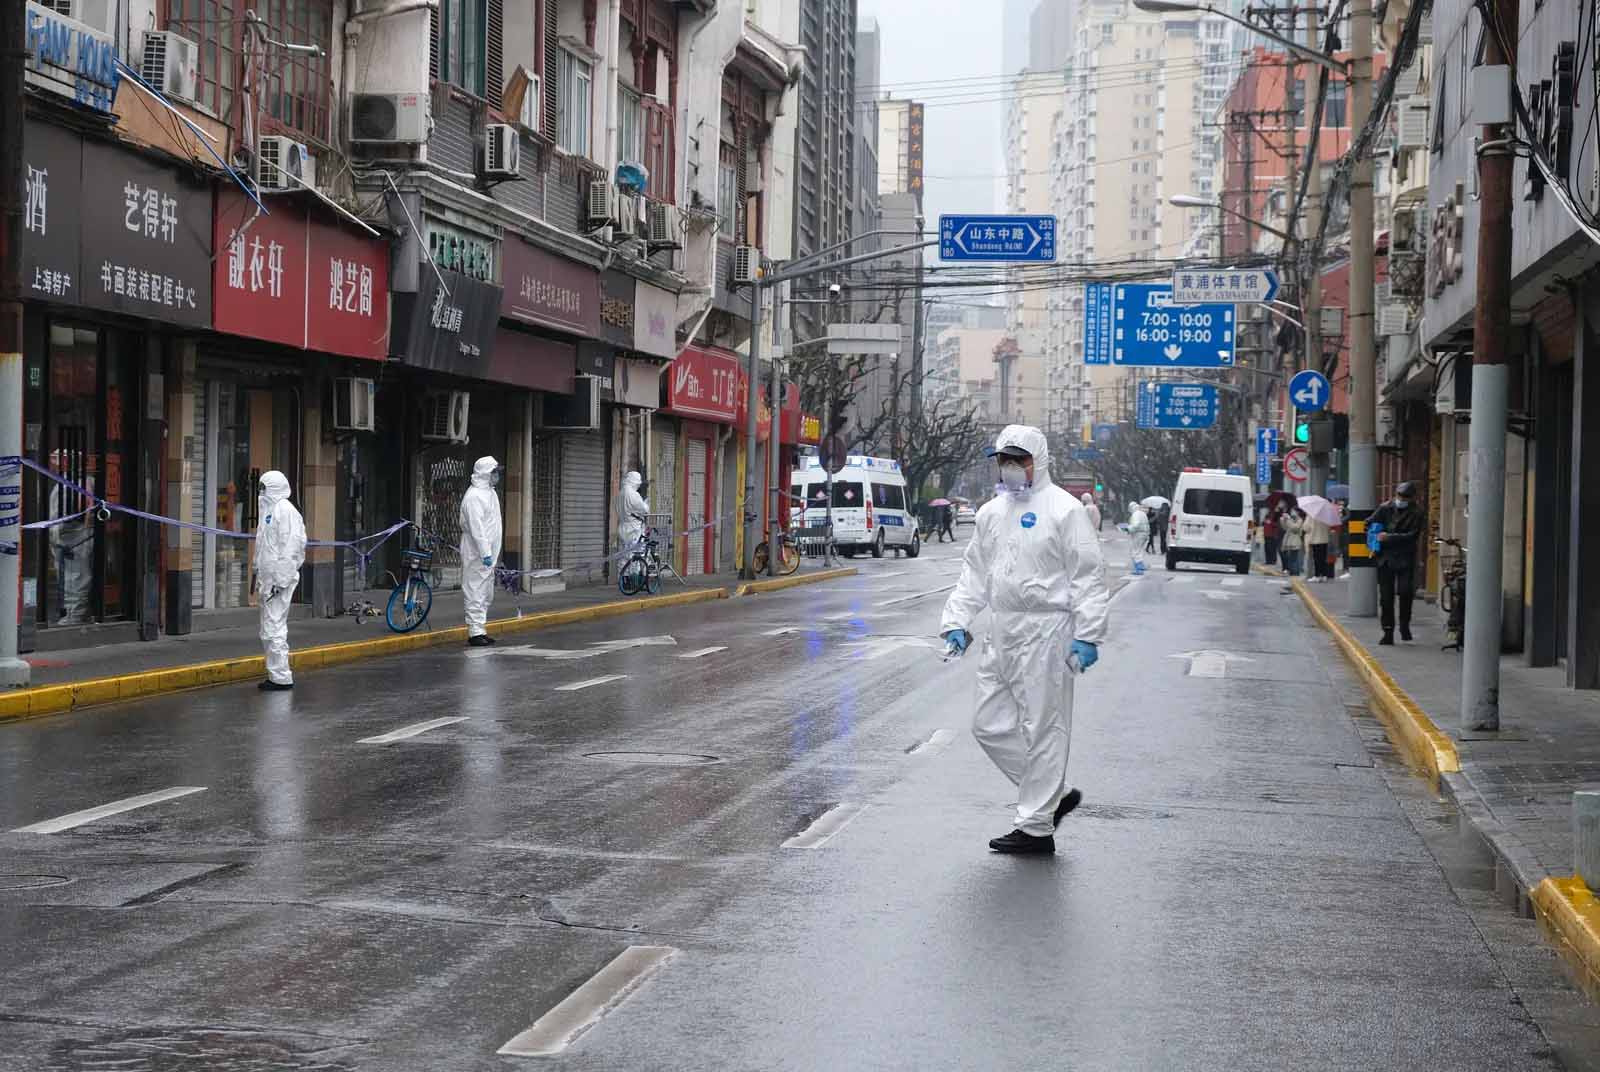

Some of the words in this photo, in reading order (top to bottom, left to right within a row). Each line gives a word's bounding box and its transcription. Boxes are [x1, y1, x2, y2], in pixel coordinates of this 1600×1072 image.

[25, 163, 48, 236] 酒
[124, 180, 178, 244] 艺得轩
[970, 226, 1024, 240] 山东中路
[971, 242, 1002, 251] Shandong
[32, 266, 71, 296] 上海特产
[101, 260, 196, 309] 书画装裱配框中心
[229, 228, 284, 298] 靓衣轩
[330, 256, 372, 317] 鸿艺阁
[1180, 274, 1258, 289] 黄浦体育馆
